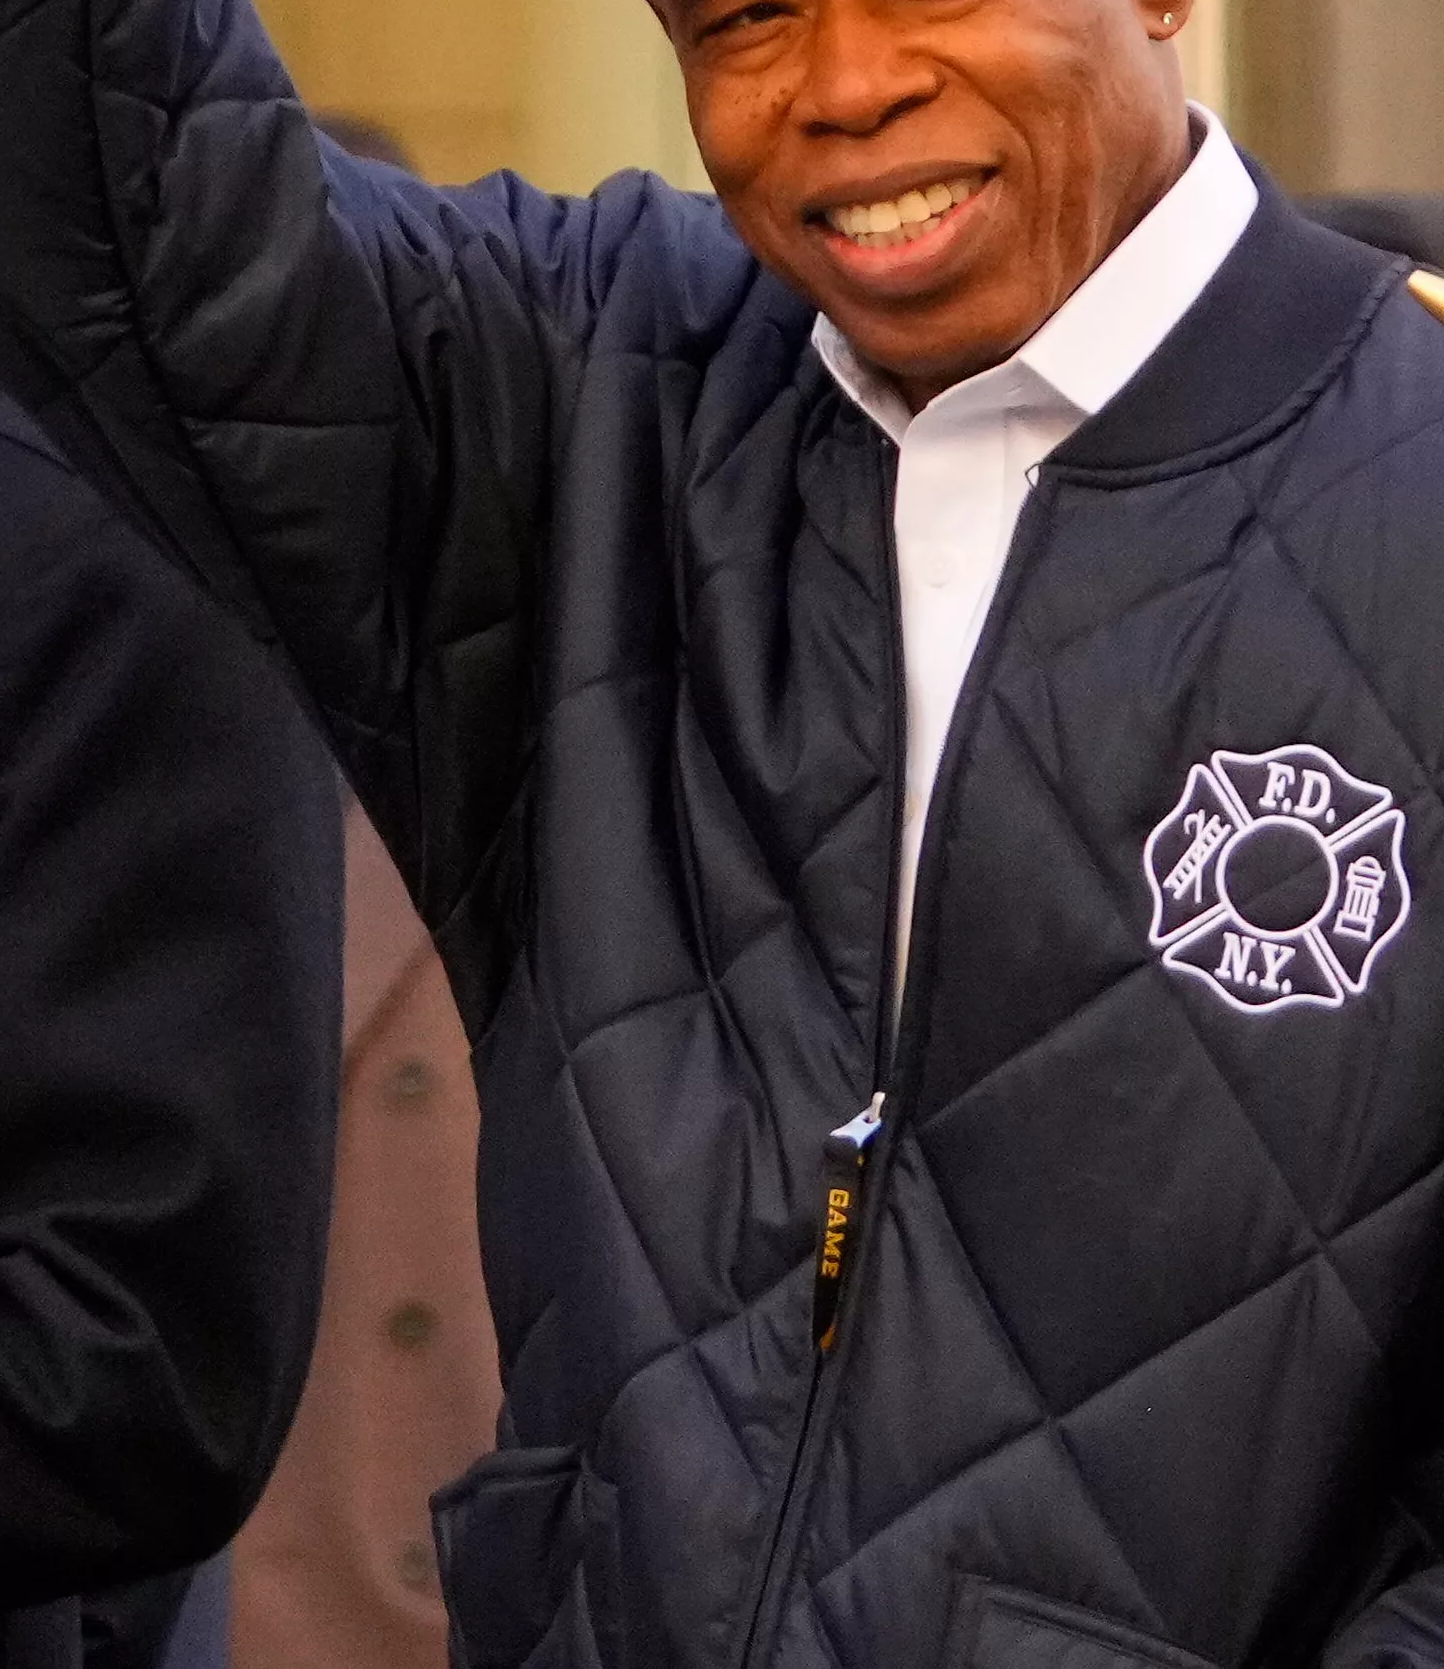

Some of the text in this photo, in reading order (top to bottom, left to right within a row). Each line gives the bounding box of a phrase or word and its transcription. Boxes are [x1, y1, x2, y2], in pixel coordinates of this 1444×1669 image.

[1258, 761, 1336, 824] F.D.
[1213, 932, 1296, 995] N.Y.
[820, 1188, 850, 1278] GAME
